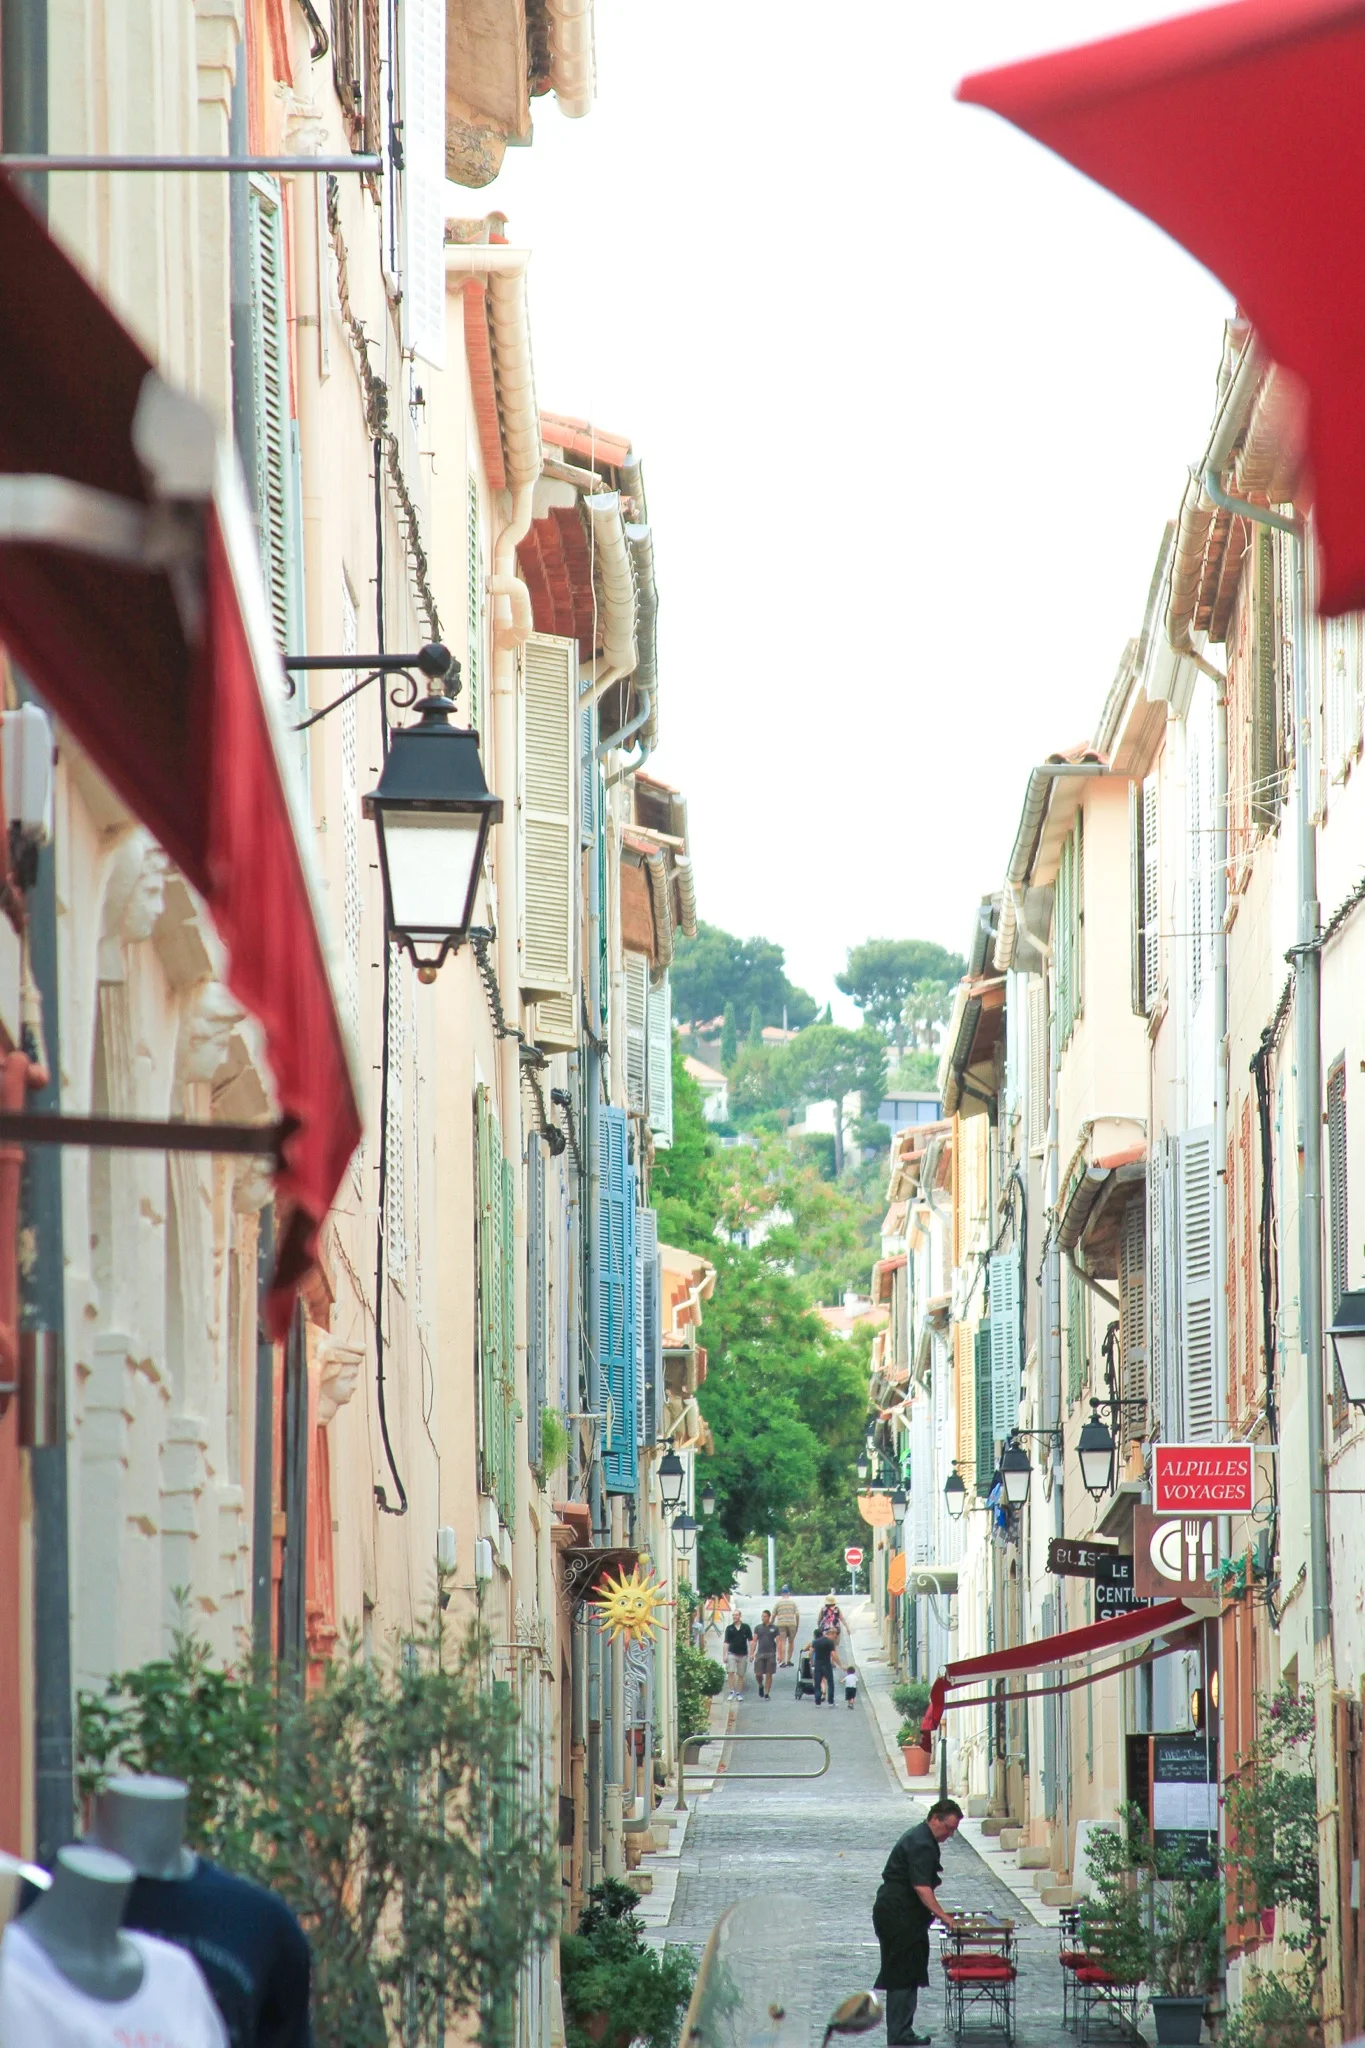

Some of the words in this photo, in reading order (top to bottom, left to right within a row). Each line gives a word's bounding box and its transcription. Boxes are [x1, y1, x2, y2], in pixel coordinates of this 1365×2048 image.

[1161, 1460, 1248, 1477] ALPILLES
[1163, 1484, 1246, 1500] VOYAGES
[1112, 1564, 1129, 1578] LE
